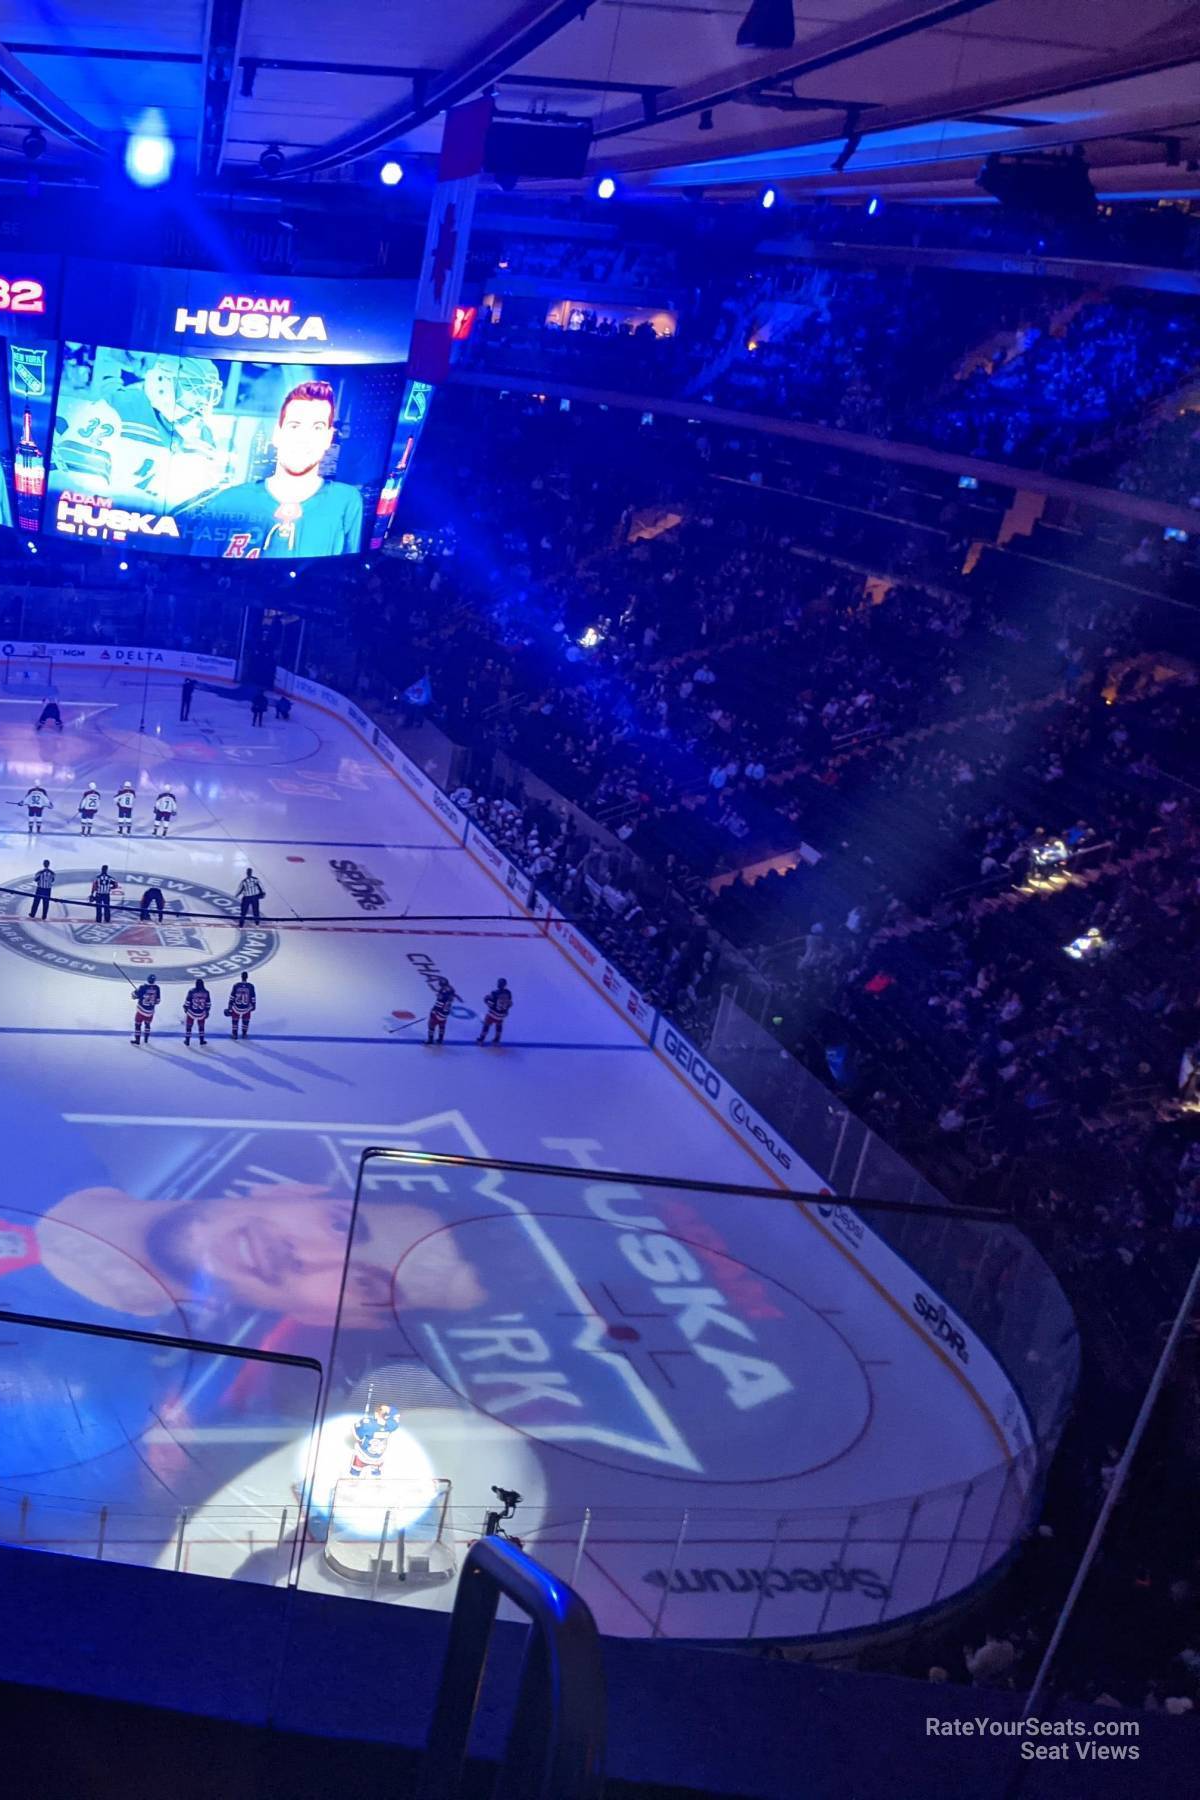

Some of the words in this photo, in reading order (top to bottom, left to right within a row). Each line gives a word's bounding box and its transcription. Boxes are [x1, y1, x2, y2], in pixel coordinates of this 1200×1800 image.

[218, 295, 291, 315] ADAM
[174, 307, 328, 342] HUSKA
[59, 490, 114, 509] ADAM
[56, 500, 181, 539] HUSKA
[181, 523, 244, 543] HASE
[115, 650, 164, 663] DELTA
[125, 873, 194, 892] NEW
[186, 929, 267, 978] RANGERS
[22, 943, 96, 971] GARDEN
[664, 1028, 721, 1101] GEICO
[745, 1116, 792, 1171] LEXUS
[540, 1135, 794, 1411] HUSKA
[666, 1561, 892, 1600] Spectrum
